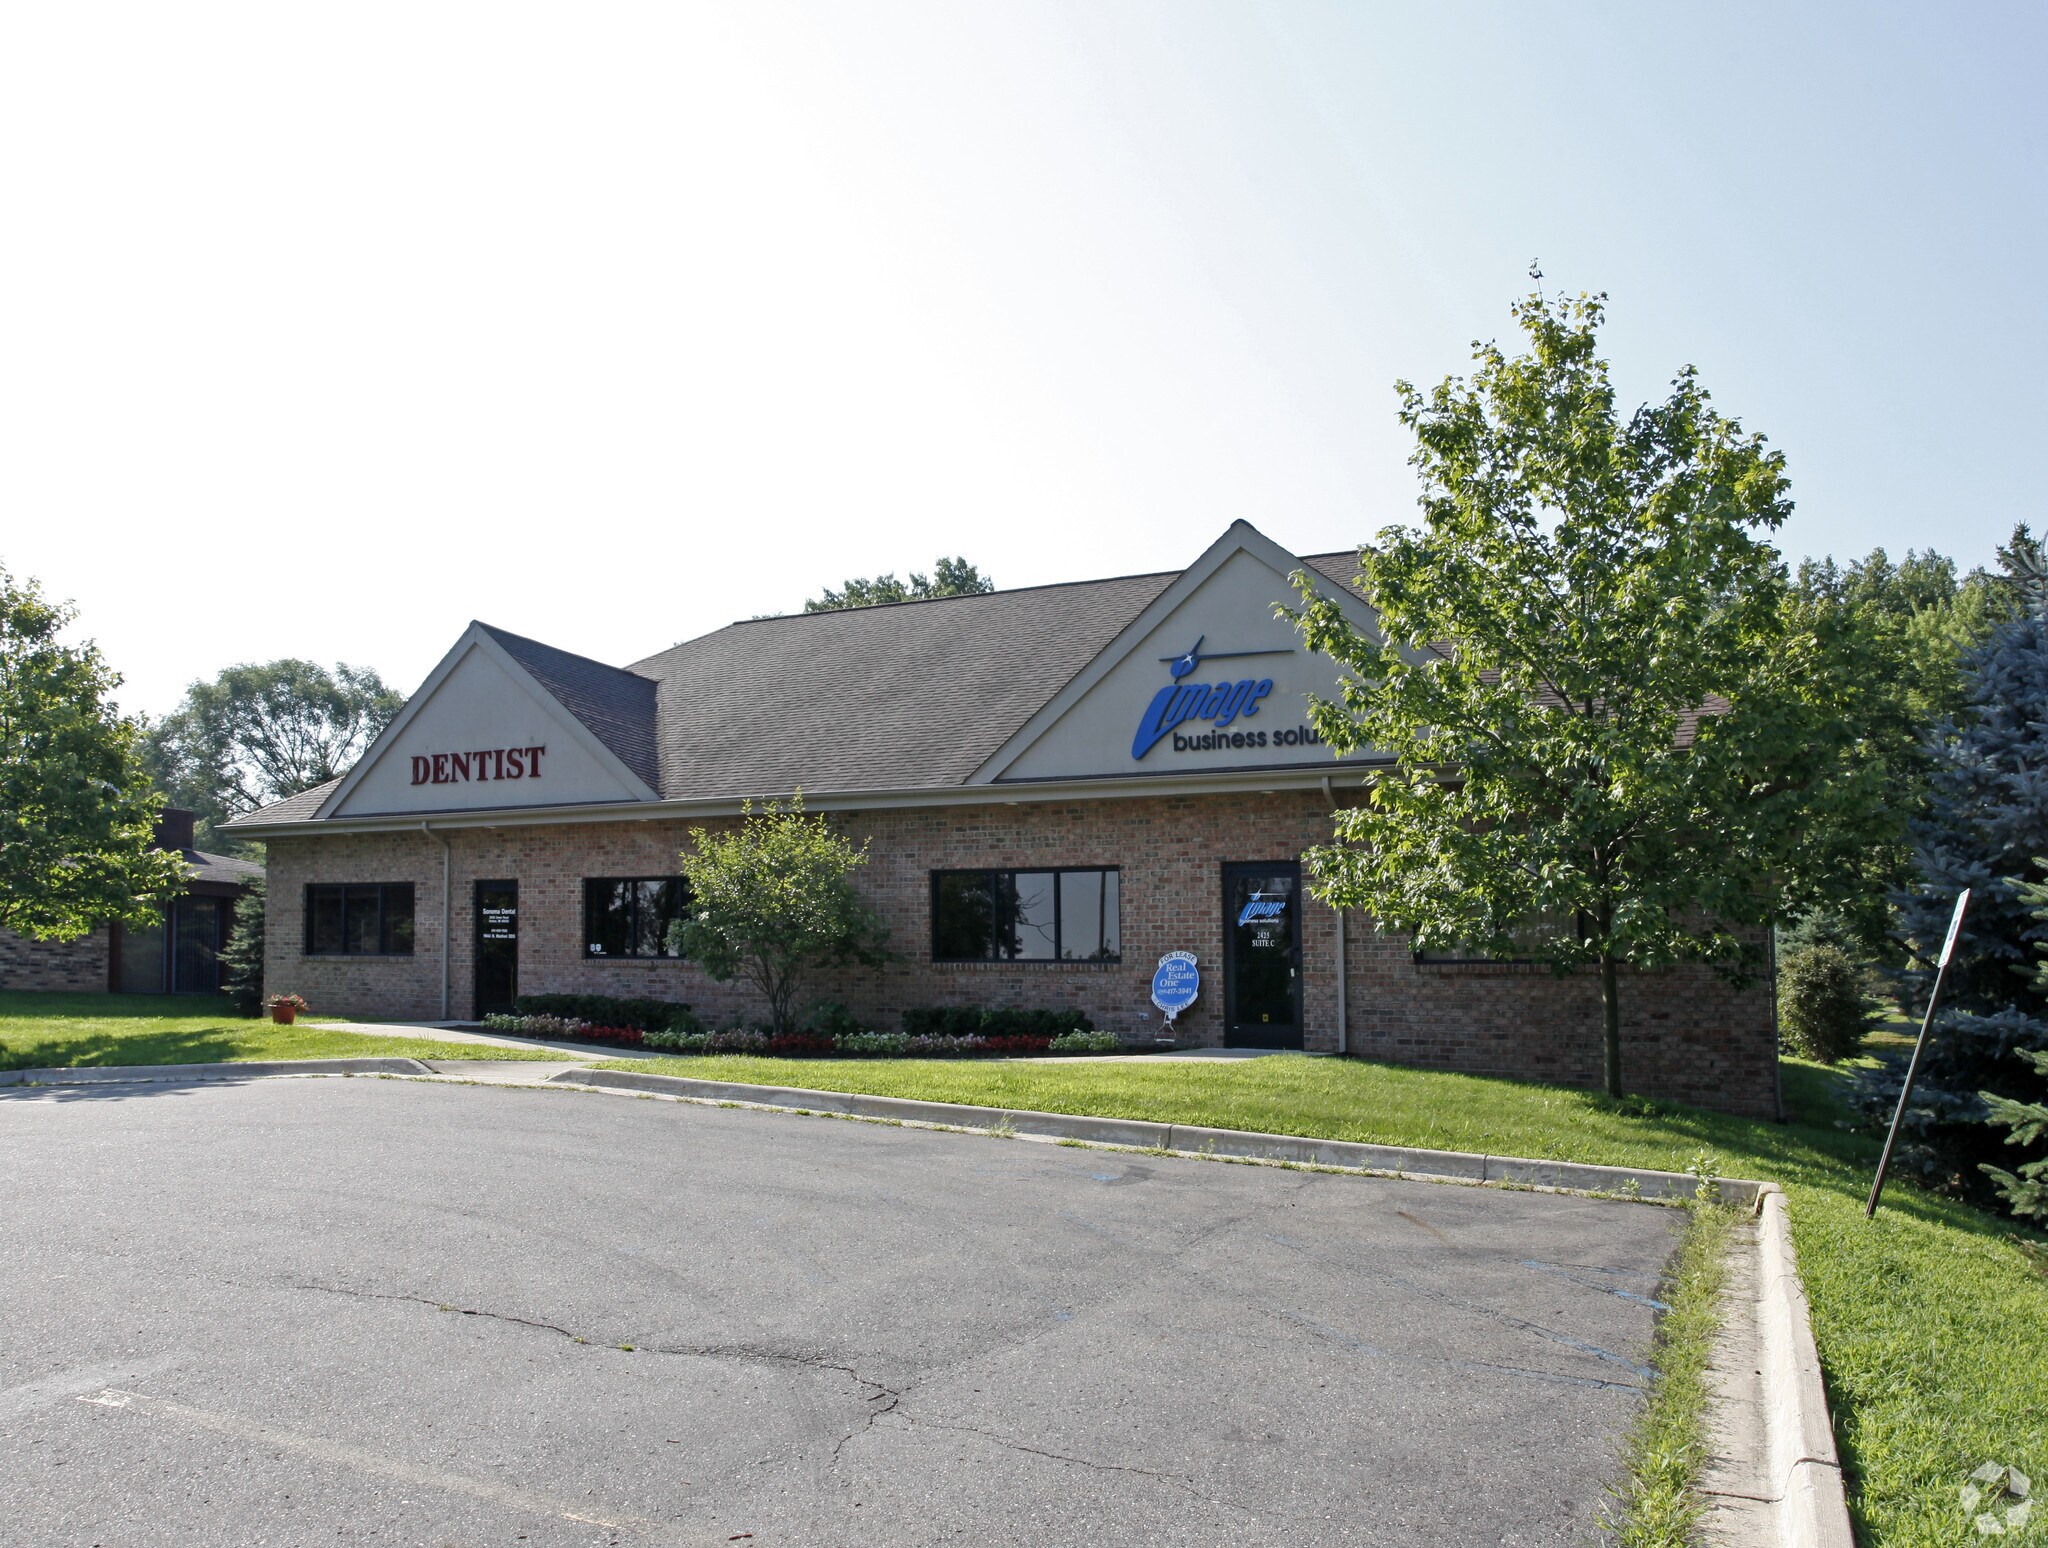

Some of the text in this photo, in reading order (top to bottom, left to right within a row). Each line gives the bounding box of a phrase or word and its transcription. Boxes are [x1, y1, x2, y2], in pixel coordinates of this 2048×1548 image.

[1173, 730, 1267, 751] business
[410, 745, 545, 785] DENTIST
[1257, 931, 1270, 939] 2425
[1160, 951, 1196, 964] FOR LEASE
[1166, 962, 1186, 972] Real
[1168, 972, 1195, 980] Estate
[1160, 979, 1179, 988] One
